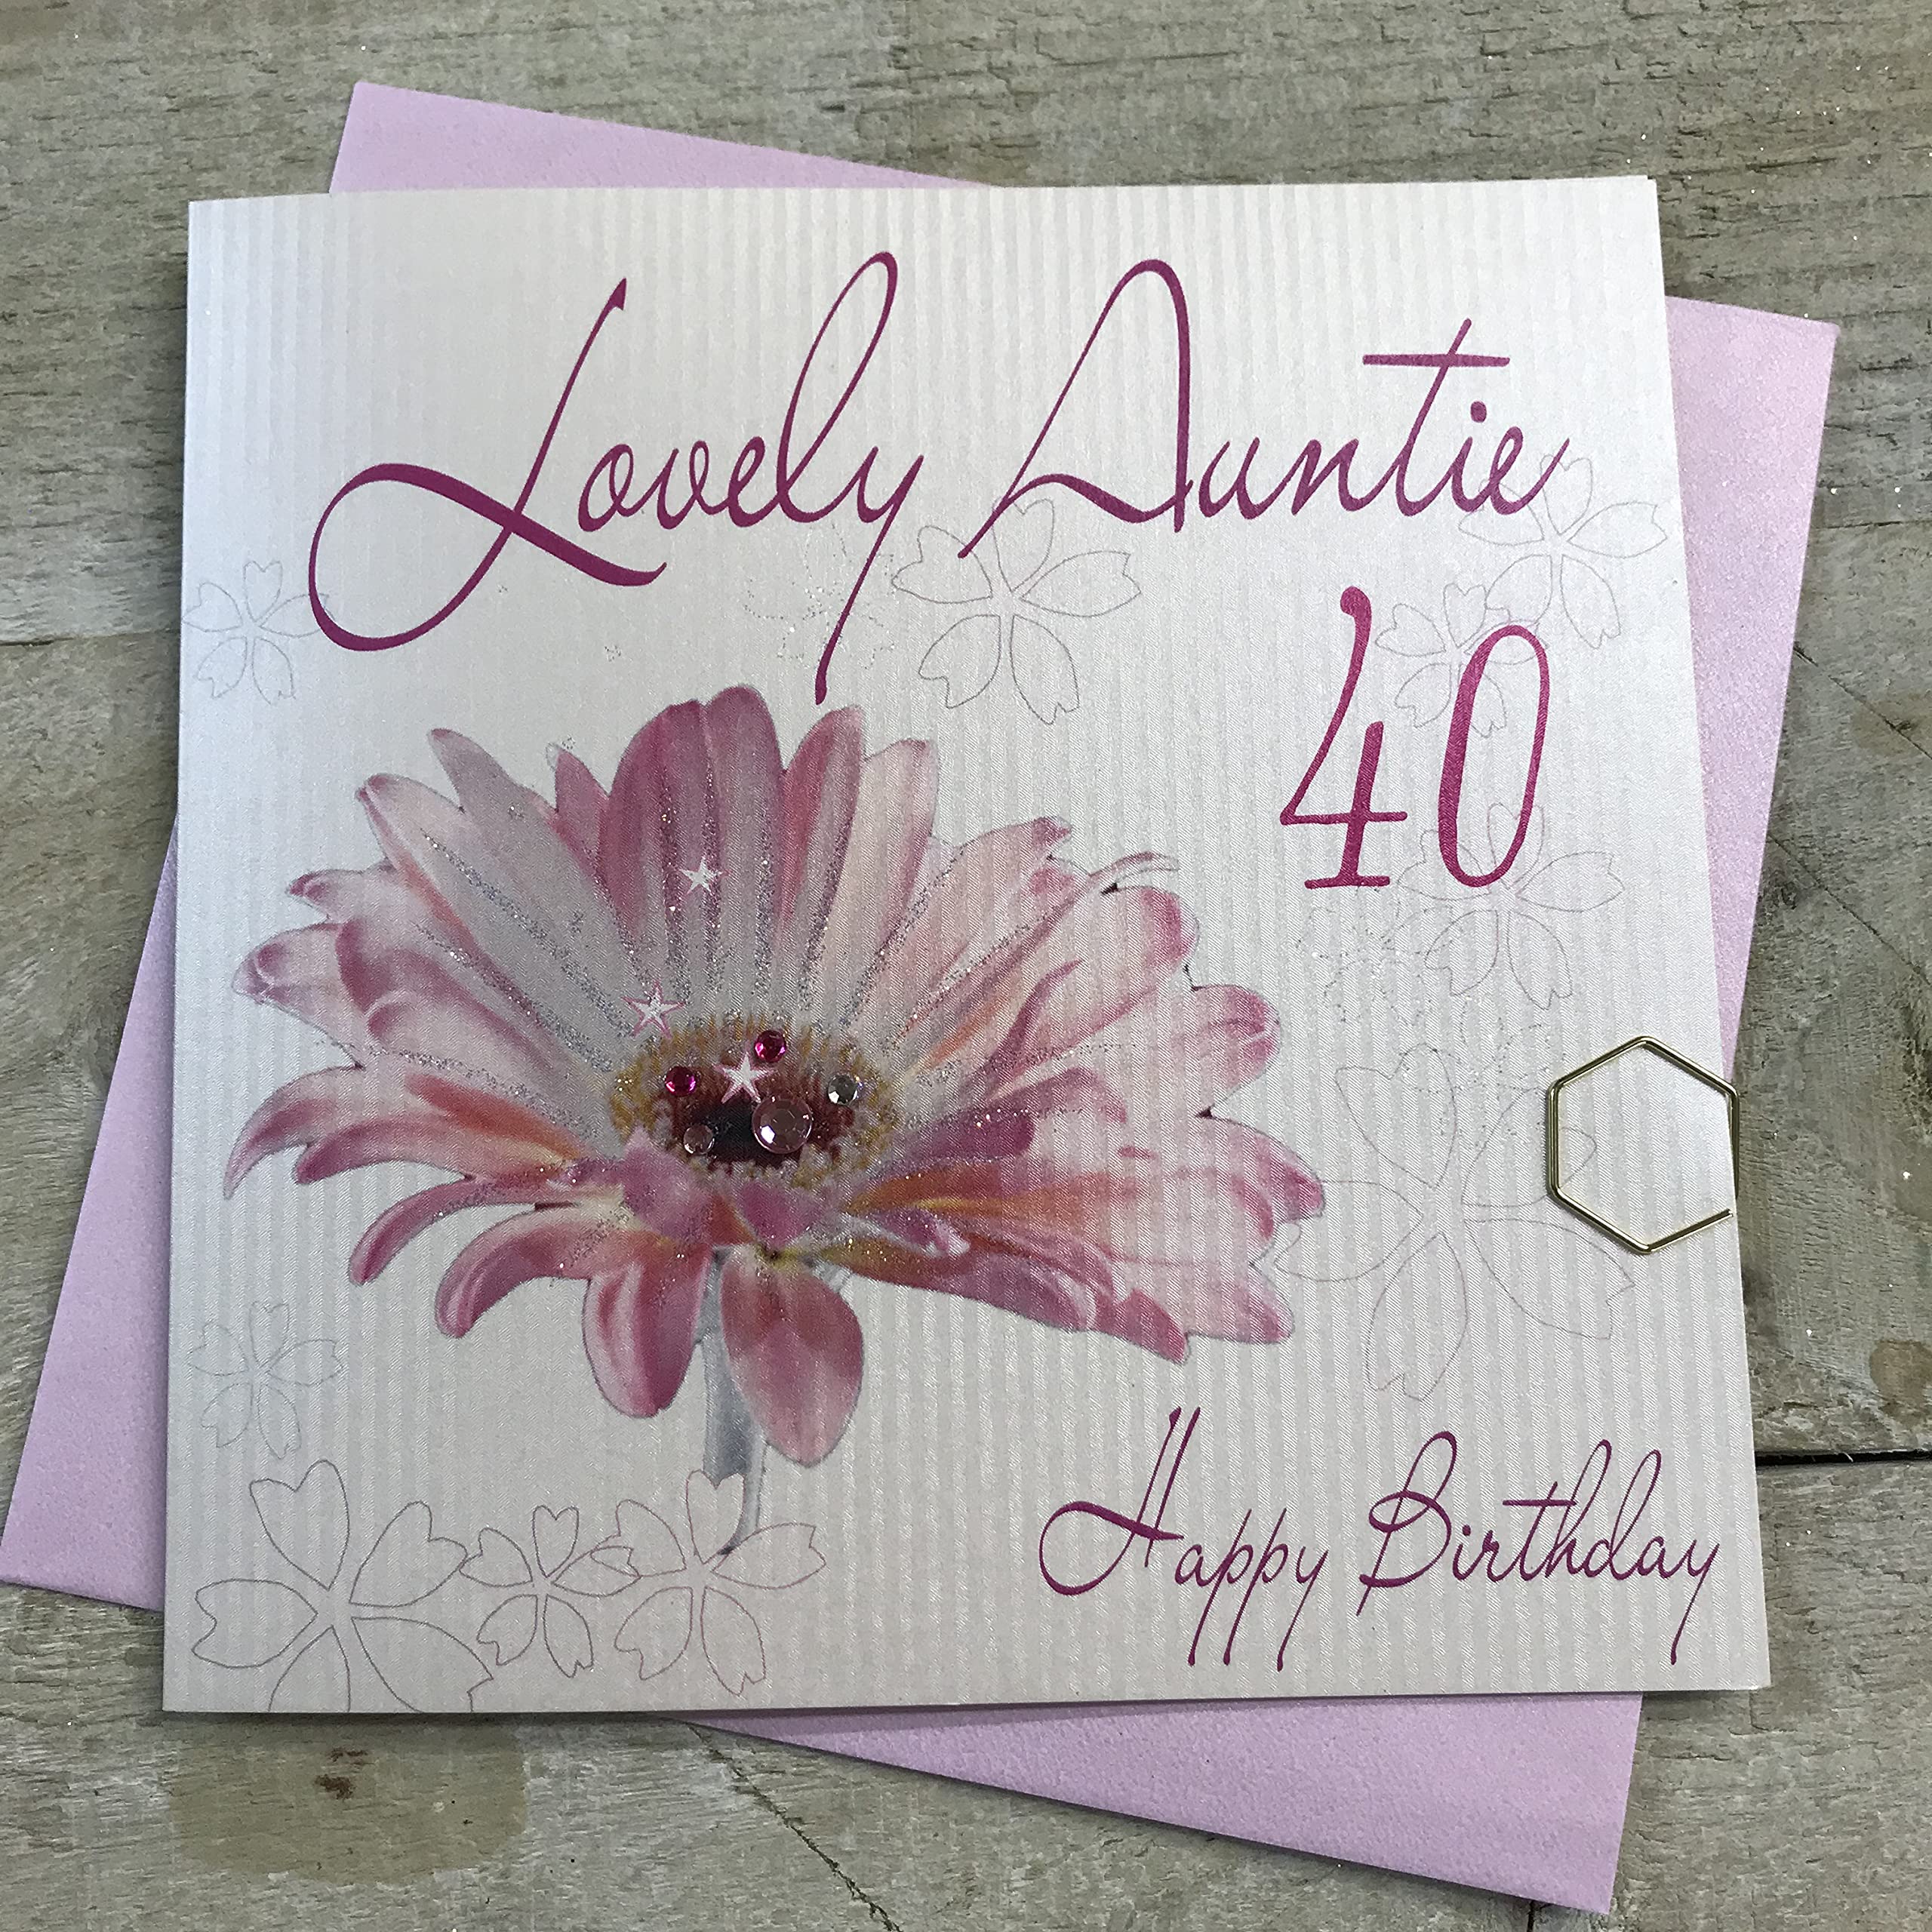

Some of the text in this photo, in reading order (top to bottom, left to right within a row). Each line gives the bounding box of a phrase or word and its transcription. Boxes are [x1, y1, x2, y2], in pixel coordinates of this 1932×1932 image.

[308, 251, 1571, 706] Lovely Auntie
[1279, 586, 1551, 890] 40
[1039, 1407, 1720, 1672] Happy Birthday
